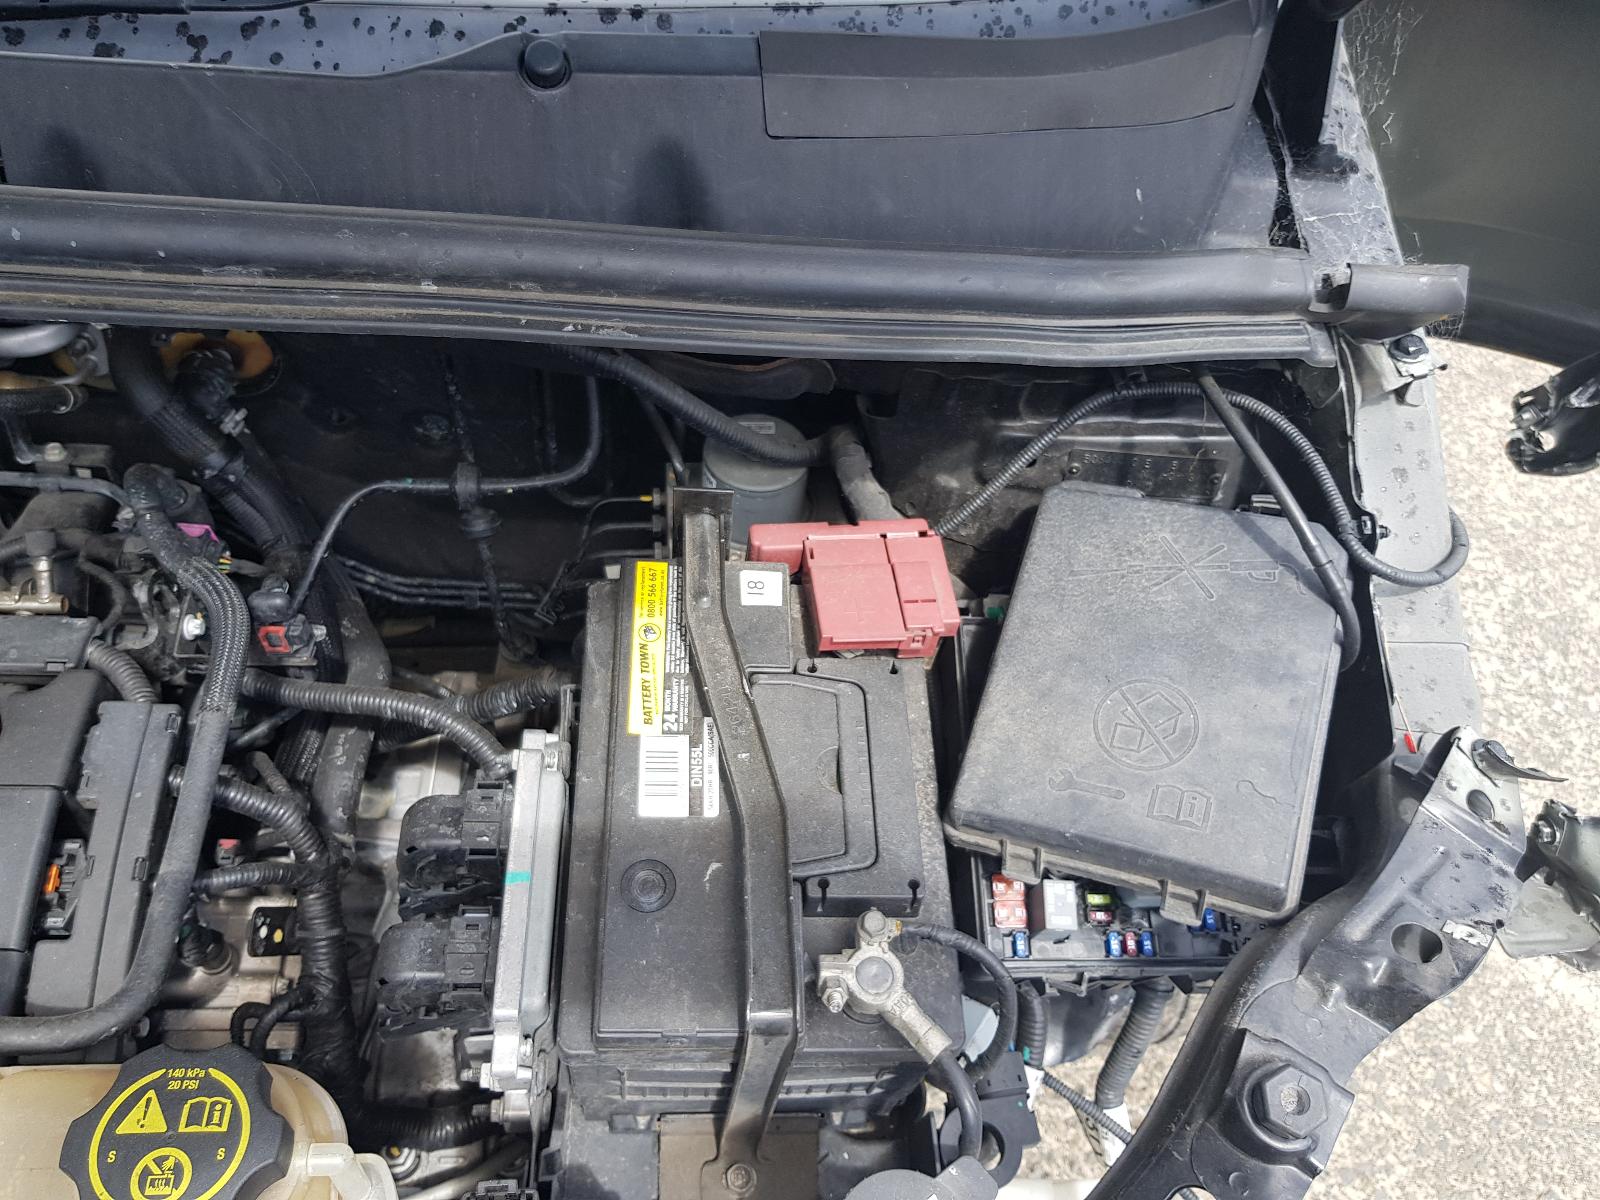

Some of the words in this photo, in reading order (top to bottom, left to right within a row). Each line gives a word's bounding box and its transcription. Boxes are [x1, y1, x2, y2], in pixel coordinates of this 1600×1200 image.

[648, 568, 657, 581] 667
[648, 584, 657, 597] 566
[647, 599, 655, 618] 0800
[639, 642, 650, 674] TOWN
[641, 678, 653, 725] BATTERY
[663, 713, 678, 732] 24
[690, 744, 703, 787] DIN55L
[167, 1068, 185, 1078] 140
[187, 1068, 205, 1078] kPa
[168, 1080, 181, 1089] 20
[182, 1080, 199, 1090] PSI
[107, 1150, 116, 1163] S
[217, 1148, 226, 1160] S
